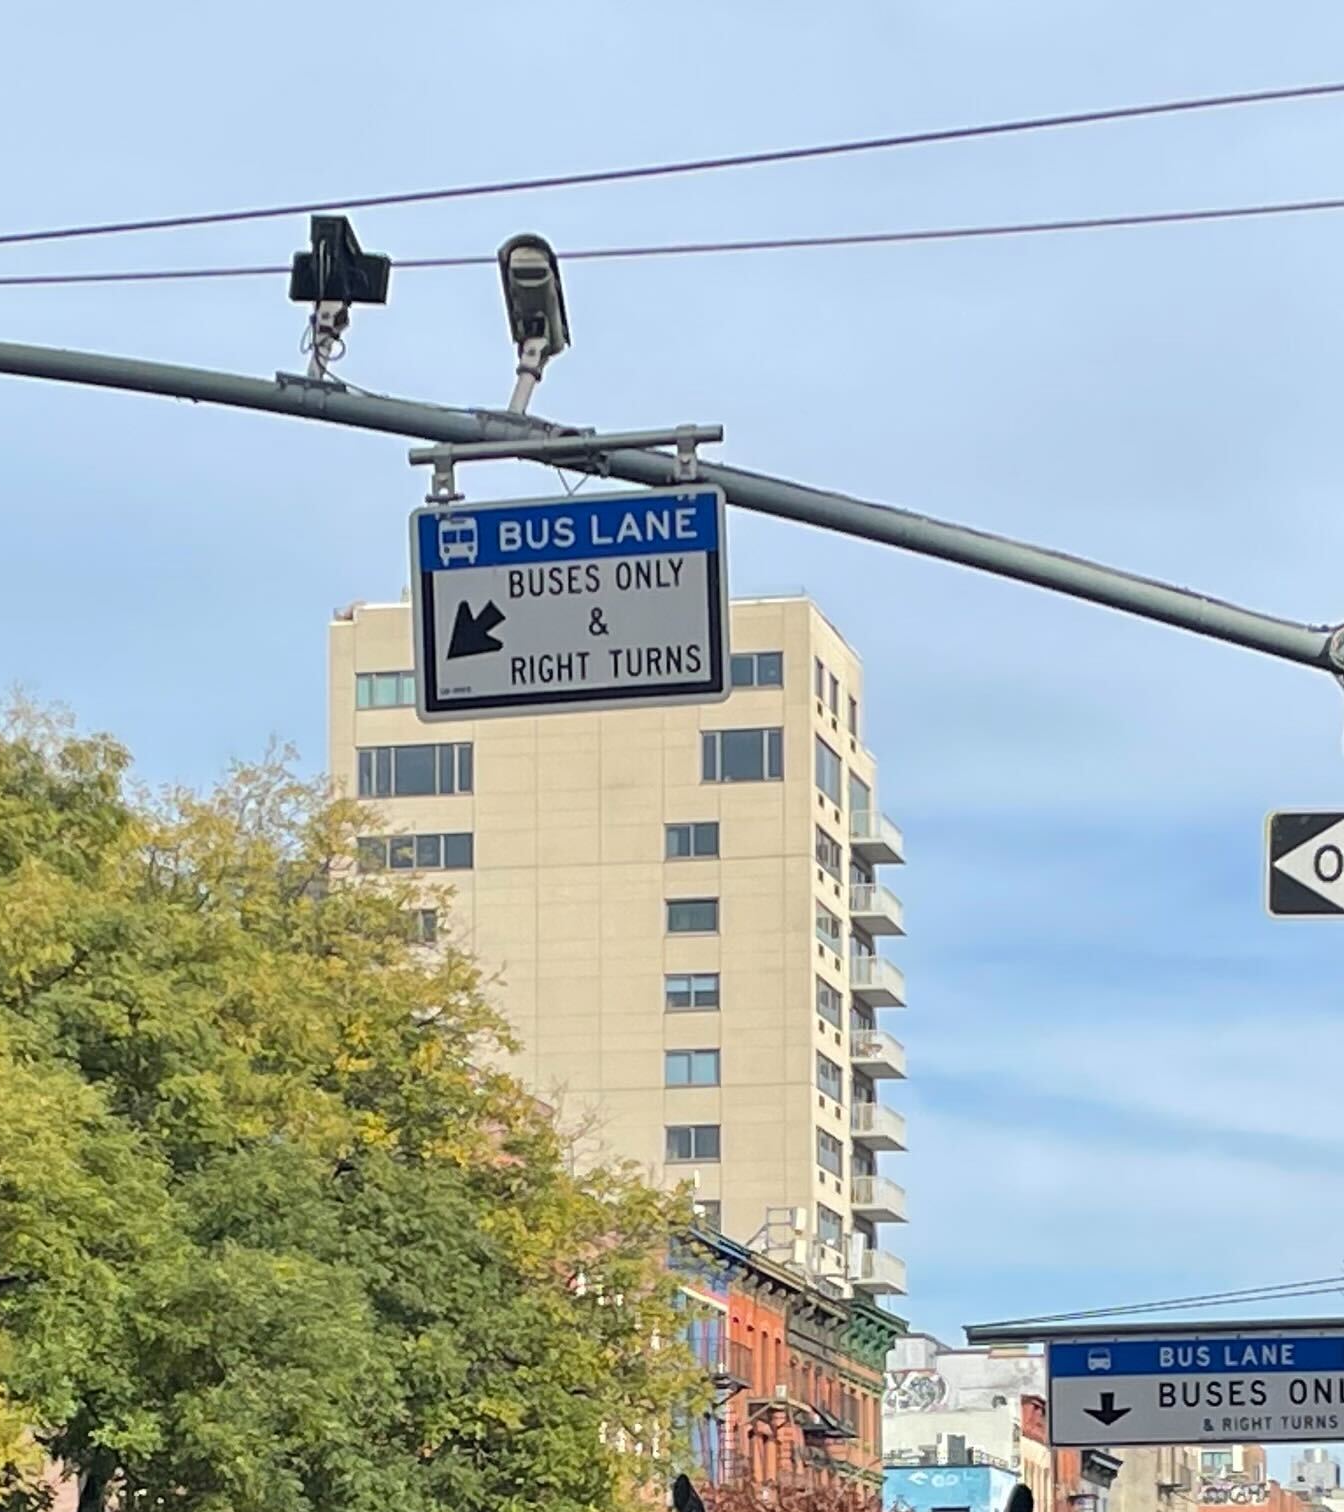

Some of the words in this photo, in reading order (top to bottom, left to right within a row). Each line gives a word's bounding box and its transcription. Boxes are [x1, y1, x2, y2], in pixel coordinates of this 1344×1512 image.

[498, 516, 577, 553] BUS
[590, 507, 699, 544] LANE
[508, 562, 602, 599] BUSES
[615, 557, 684, 590] ONLY
[587, 606, 610, 637] &
[510, 651, 591, 686] RIGHT
[608, 643, 702, 679] TURNS
[1158, 1345, 1211, 1368] BUS
[1223, 1344, 1296, 1366] LANE
[1158, 1380, 1268, 1408] BUSES
[1202, 1418, 1214, 1432] &
[1222, 1417, 1273, 1432] RIGHT
[1281, 1415, 1339, 1430] TURNS
